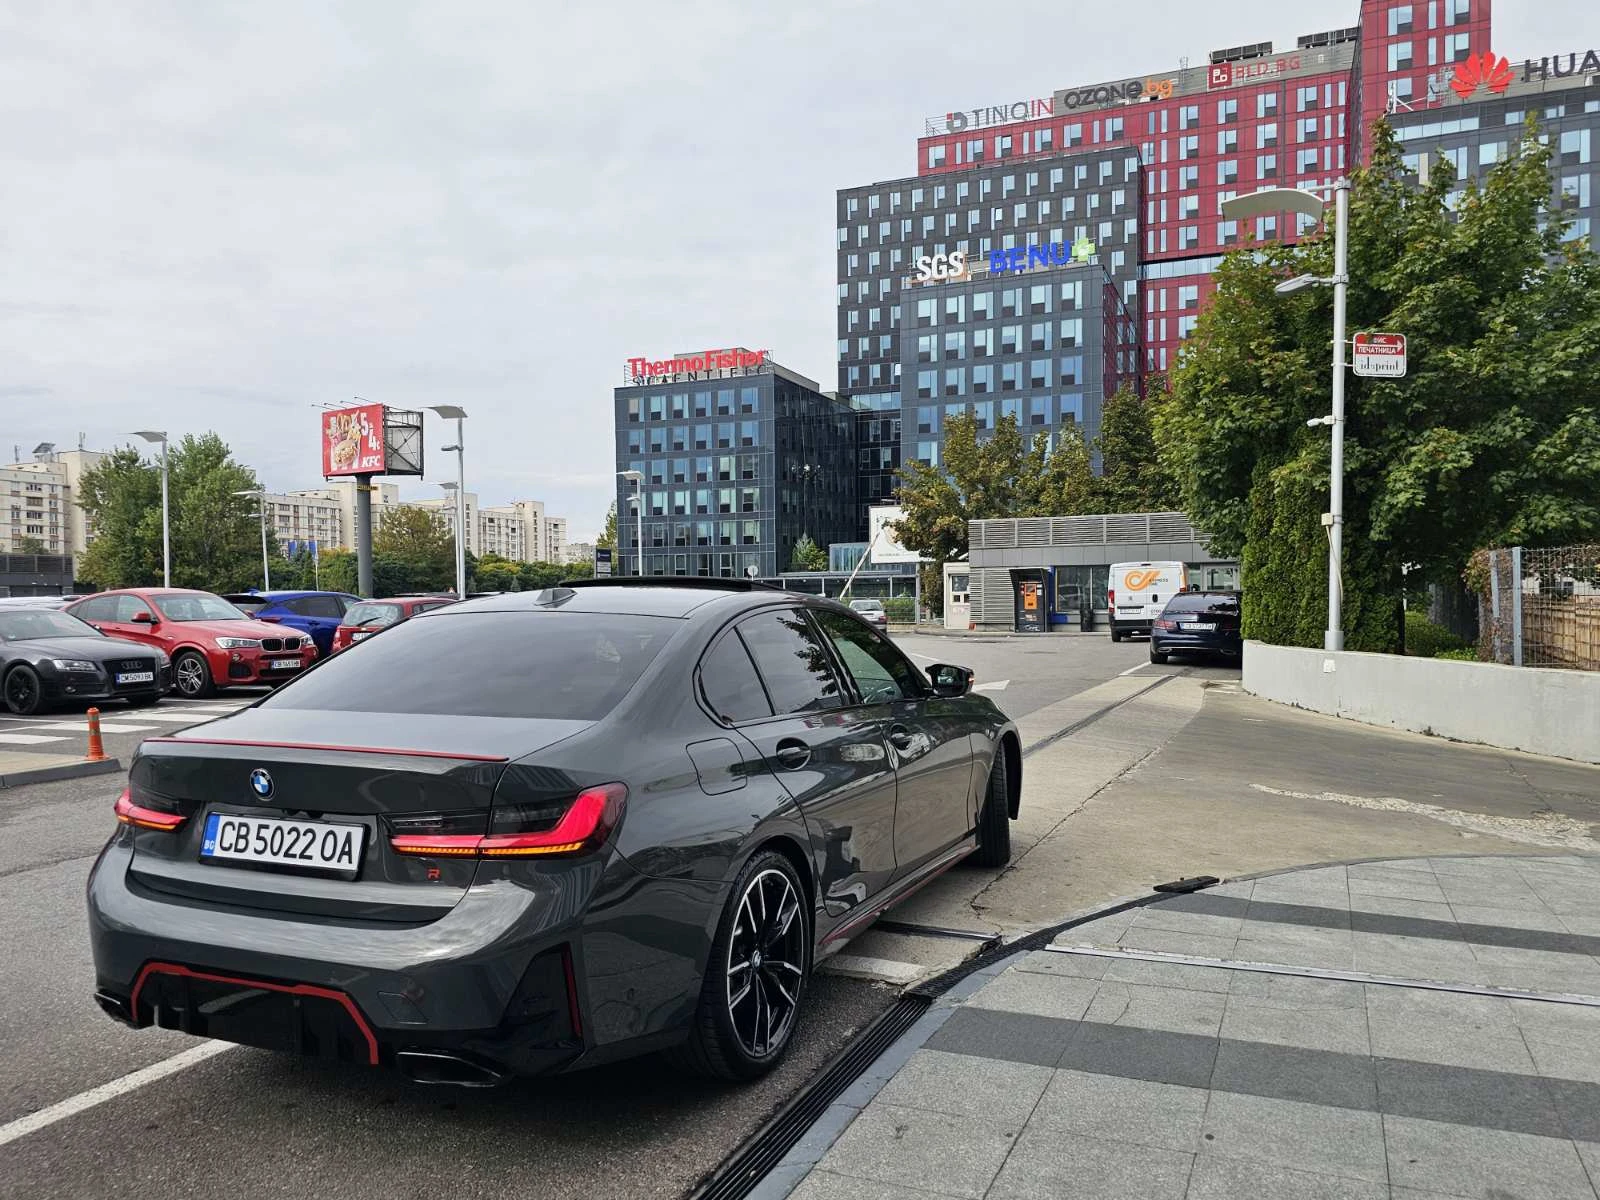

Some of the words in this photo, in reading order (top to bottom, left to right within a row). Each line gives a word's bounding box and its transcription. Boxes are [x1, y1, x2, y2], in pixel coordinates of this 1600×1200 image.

[1525, 50, 1600, 82] HUA
[972, 97, 1054, 128] TINQIN
[916, 251, 964, 282] SGS
[990, 240, 1071, 273] BENU
[1358, 346, 1396, 354] ПЕЧАТНИЦА
[361, 455, 381, 468] KFC
[220, 821, 250, 853] CB
[254, 824, 317, 861] 5022
